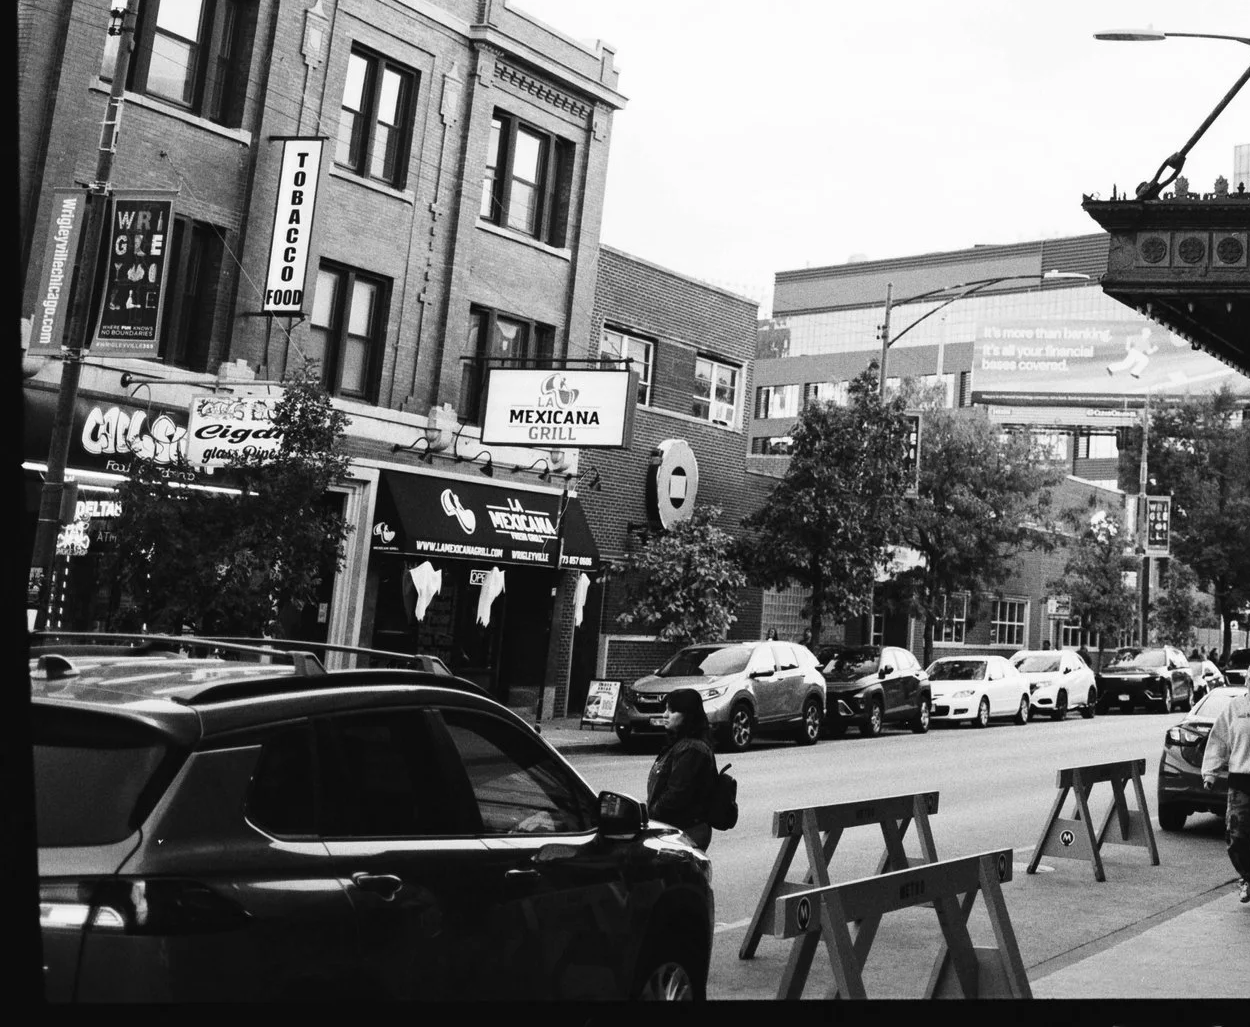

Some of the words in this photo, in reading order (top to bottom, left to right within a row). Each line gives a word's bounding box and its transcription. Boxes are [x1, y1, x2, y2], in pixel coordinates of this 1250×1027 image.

[281, 152, 309, 283] TOBACCO
[39, 198, 77, 344] Wrigleyvillechicago.com
[265, 289, 302, 306] FOOD
[1003, 329, 1034, 339] more
[1036, 328, 1062, 339] than
[1002, 344, 1016, 356] all
[1017, 347, 1043, 359] your
[1045, 345, 1094, 357] financial
[982, 359, 1016, 371] bases
[538, 396, 554, 408] LA
[509, 409, 600, 425] MEXICANA
[528, 426, 577, 441] GRILL
[507, 498, 524, 512] LA
[488, 510, 557, 535] MEXICANA
[511, 549, 550, 563] WRIGLEYVILLE
